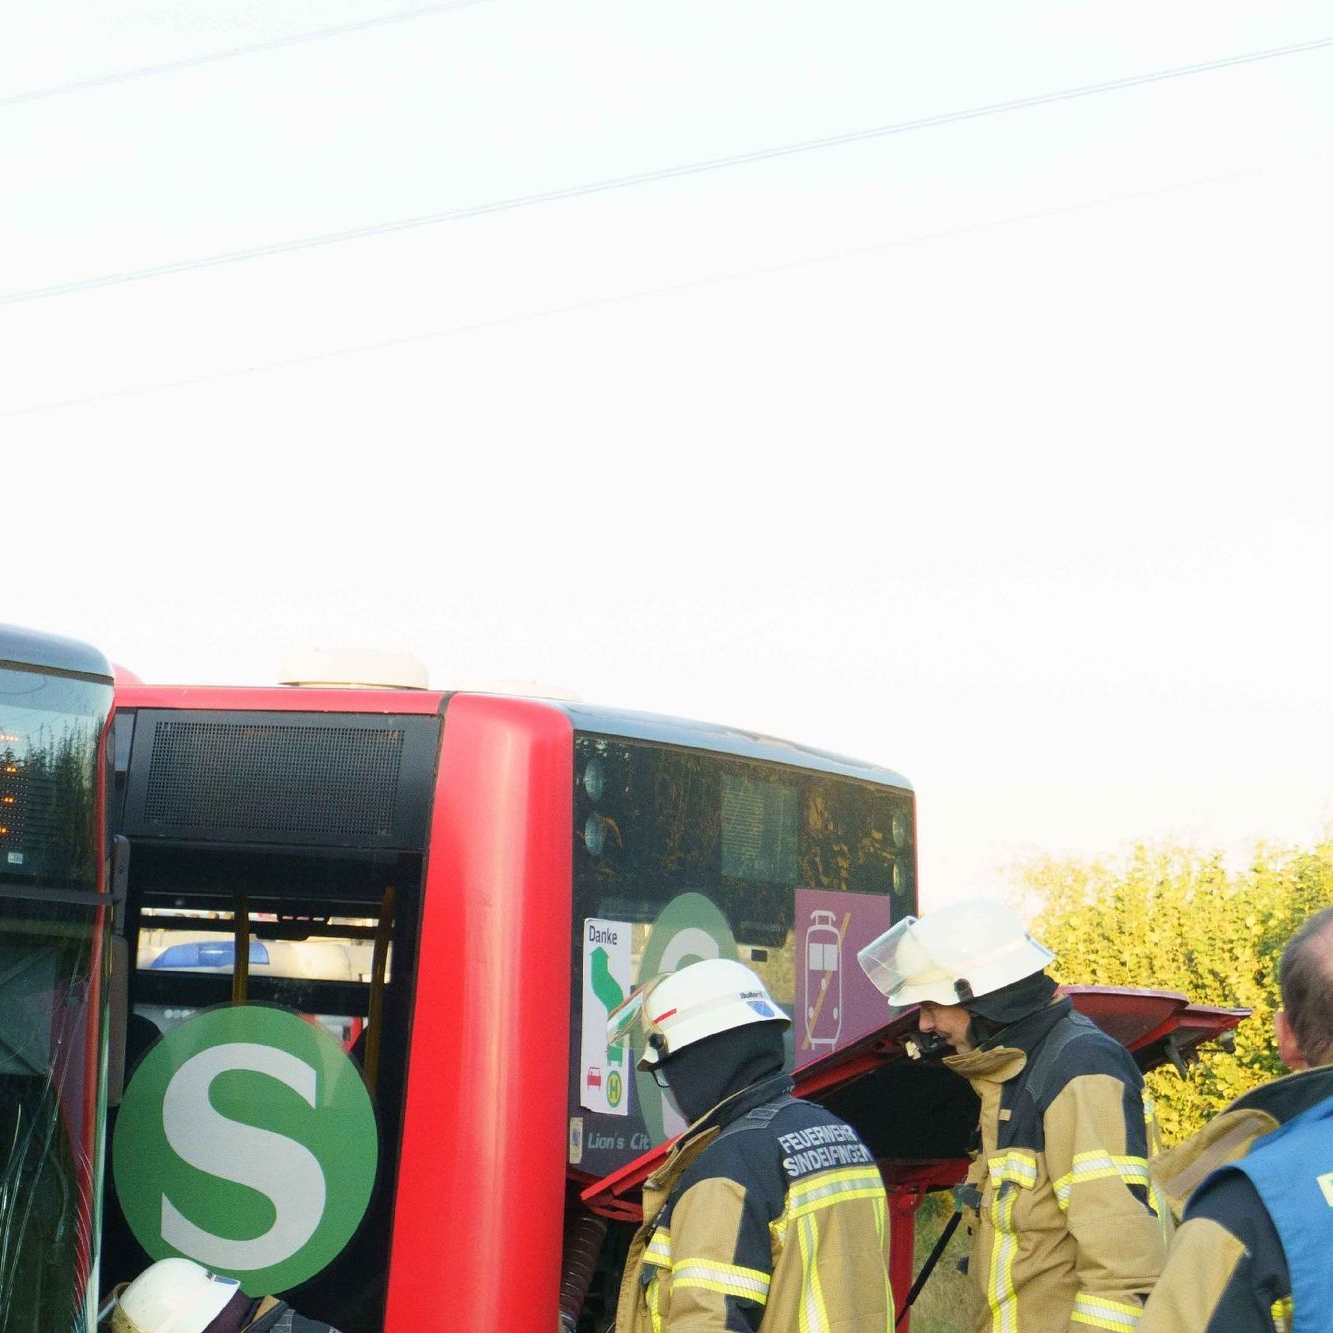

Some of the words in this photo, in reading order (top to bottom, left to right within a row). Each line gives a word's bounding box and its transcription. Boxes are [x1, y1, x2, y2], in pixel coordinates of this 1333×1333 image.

[589, 925, 619, 947] Danke
[587, 1132, 625, 1150] Lion's
[630, 1132, 651, 1150] Cit
[160, 1042, 326, 1271] S
